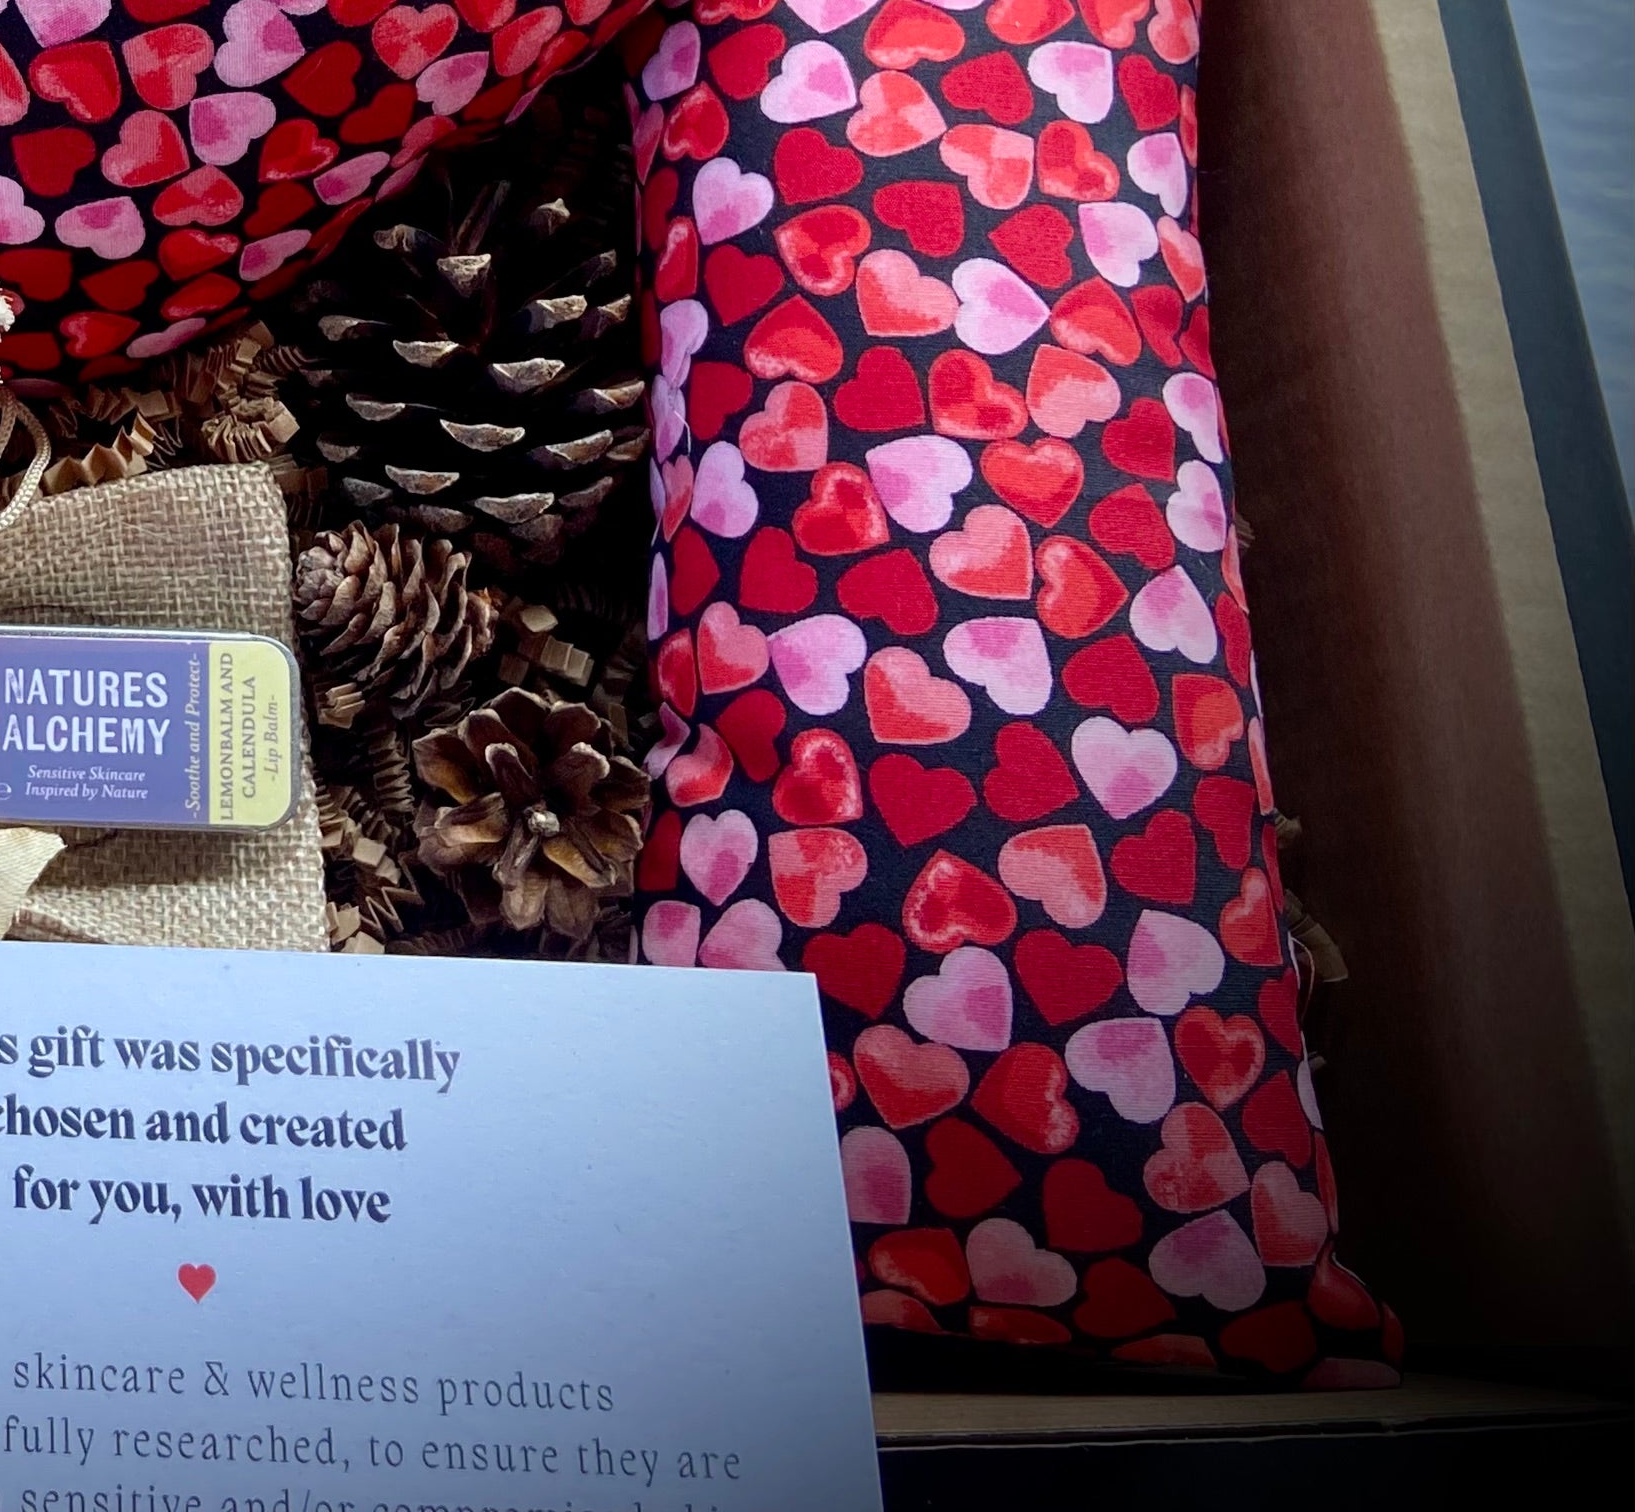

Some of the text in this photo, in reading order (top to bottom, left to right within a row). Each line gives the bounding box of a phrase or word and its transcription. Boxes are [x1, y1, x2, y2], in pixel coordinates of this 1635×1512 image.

[4, 668, 168, 708] NATURES
[2, 714, 170, 754] ALCHEMY
[184, 721, 200, 753] and
[219, 653, 234, 821] LEMONBALM AND
[242, 676, 257, 799] CALENDULA
[25, 781, 149, 801] Inspired by Nature
[27, 764, 146, 782] Sensitive Skincare
[27, 1025, 105, 1078] gift
[113, 1038, 201, 1072] was
[210, 1036, 460, 1092] specifically
[144, 1102, 231, 1144] and
[239, 1109, 408, 1150] created
[13, 1164, 391, 1225] for you, with love
[13, 1352, 185, 1394] skincare
[204, 1361, 229, 1396] &
[247, 1363, 419, 1403] wellness
[436, 1371, 613, 1415] products
[113, 1425, 349, 1470] researched,
[369, 1436, 404, 1468] to
[422, 1442, 558, 1473] ensure
[578, 1438, 658, 1487] they
[677, 1452, 740, 1479] are
